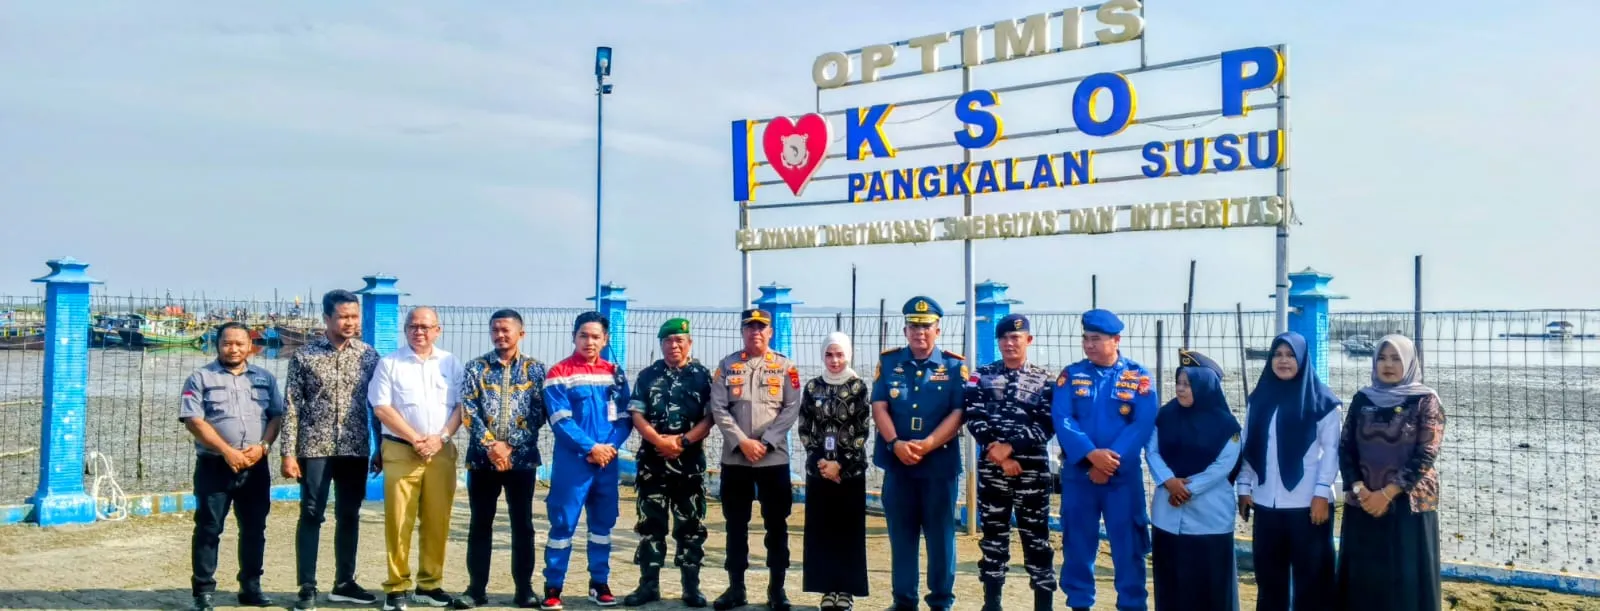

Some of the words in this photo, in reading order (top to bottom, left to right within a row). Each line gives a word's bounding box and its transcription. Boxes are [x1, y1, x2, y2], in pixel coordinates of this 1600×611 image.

[812, 0, 1145, 89] OPTIMIS
[732, 119, 755, 201] I
[847, 149, 1096, 202] PANGKALAN
[1140, 130, 1284, 178] SUSU
[824, 217, 937, 247] DIGITALISASI
[944, 210, 1060, 240] SINERGITAS
[1069, 205, 1118, 234] DAN
[1130, 194, 1284, 231] INTEGRITAS
